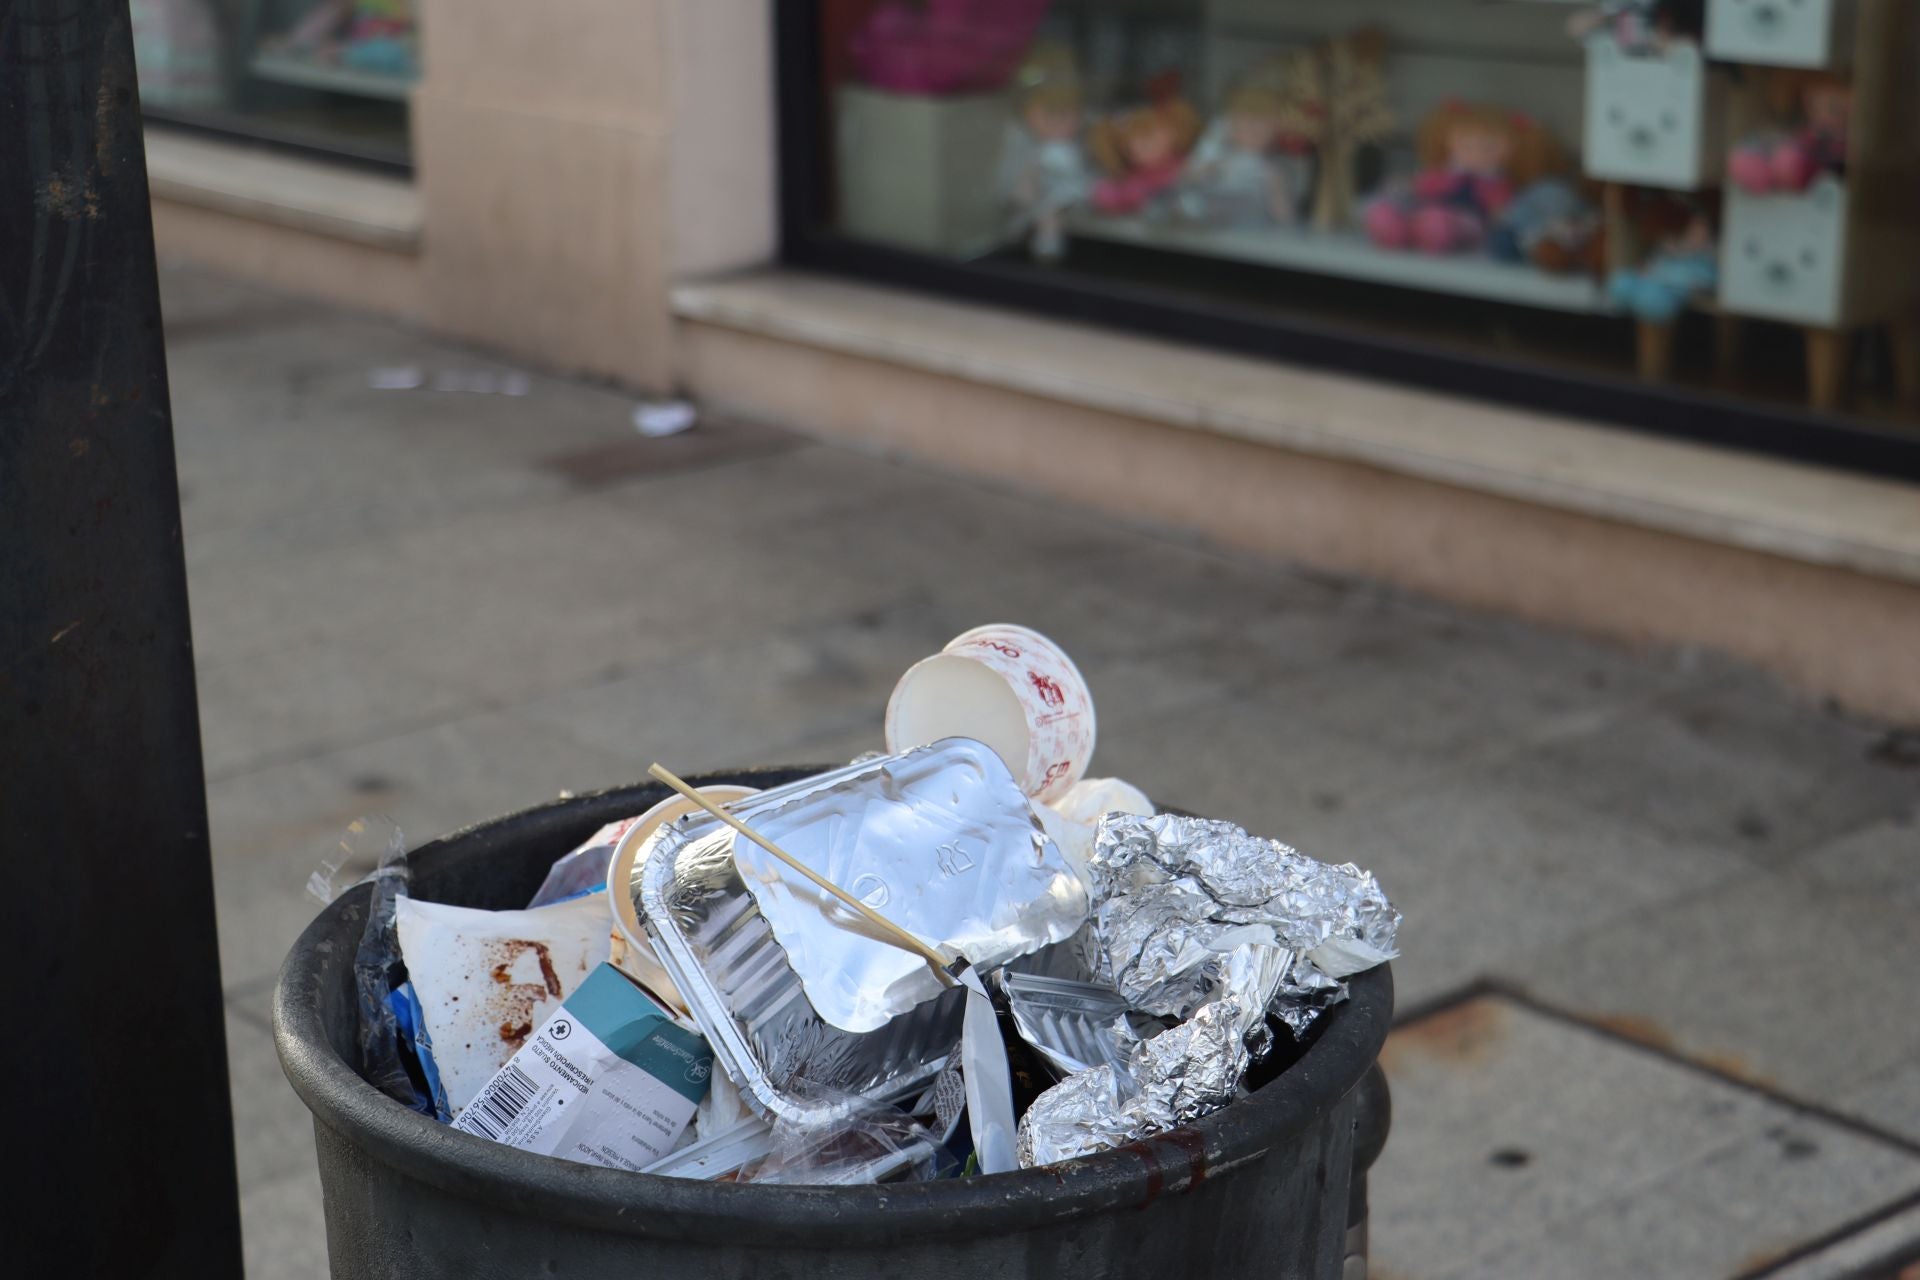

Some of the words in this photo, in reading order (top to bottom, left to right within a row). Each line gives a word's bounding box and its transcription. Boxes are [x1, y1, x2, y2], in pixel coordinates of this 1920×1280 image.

[531, 1044, 551, 1063] SUJETO
[483, 1065, 512, 1097] 470006
[549, 1060, 588, 1093] MEDICAMENTO
[691, 1063, 711, 1078] gsk
[455, 1097, 485, 1129] 567067
